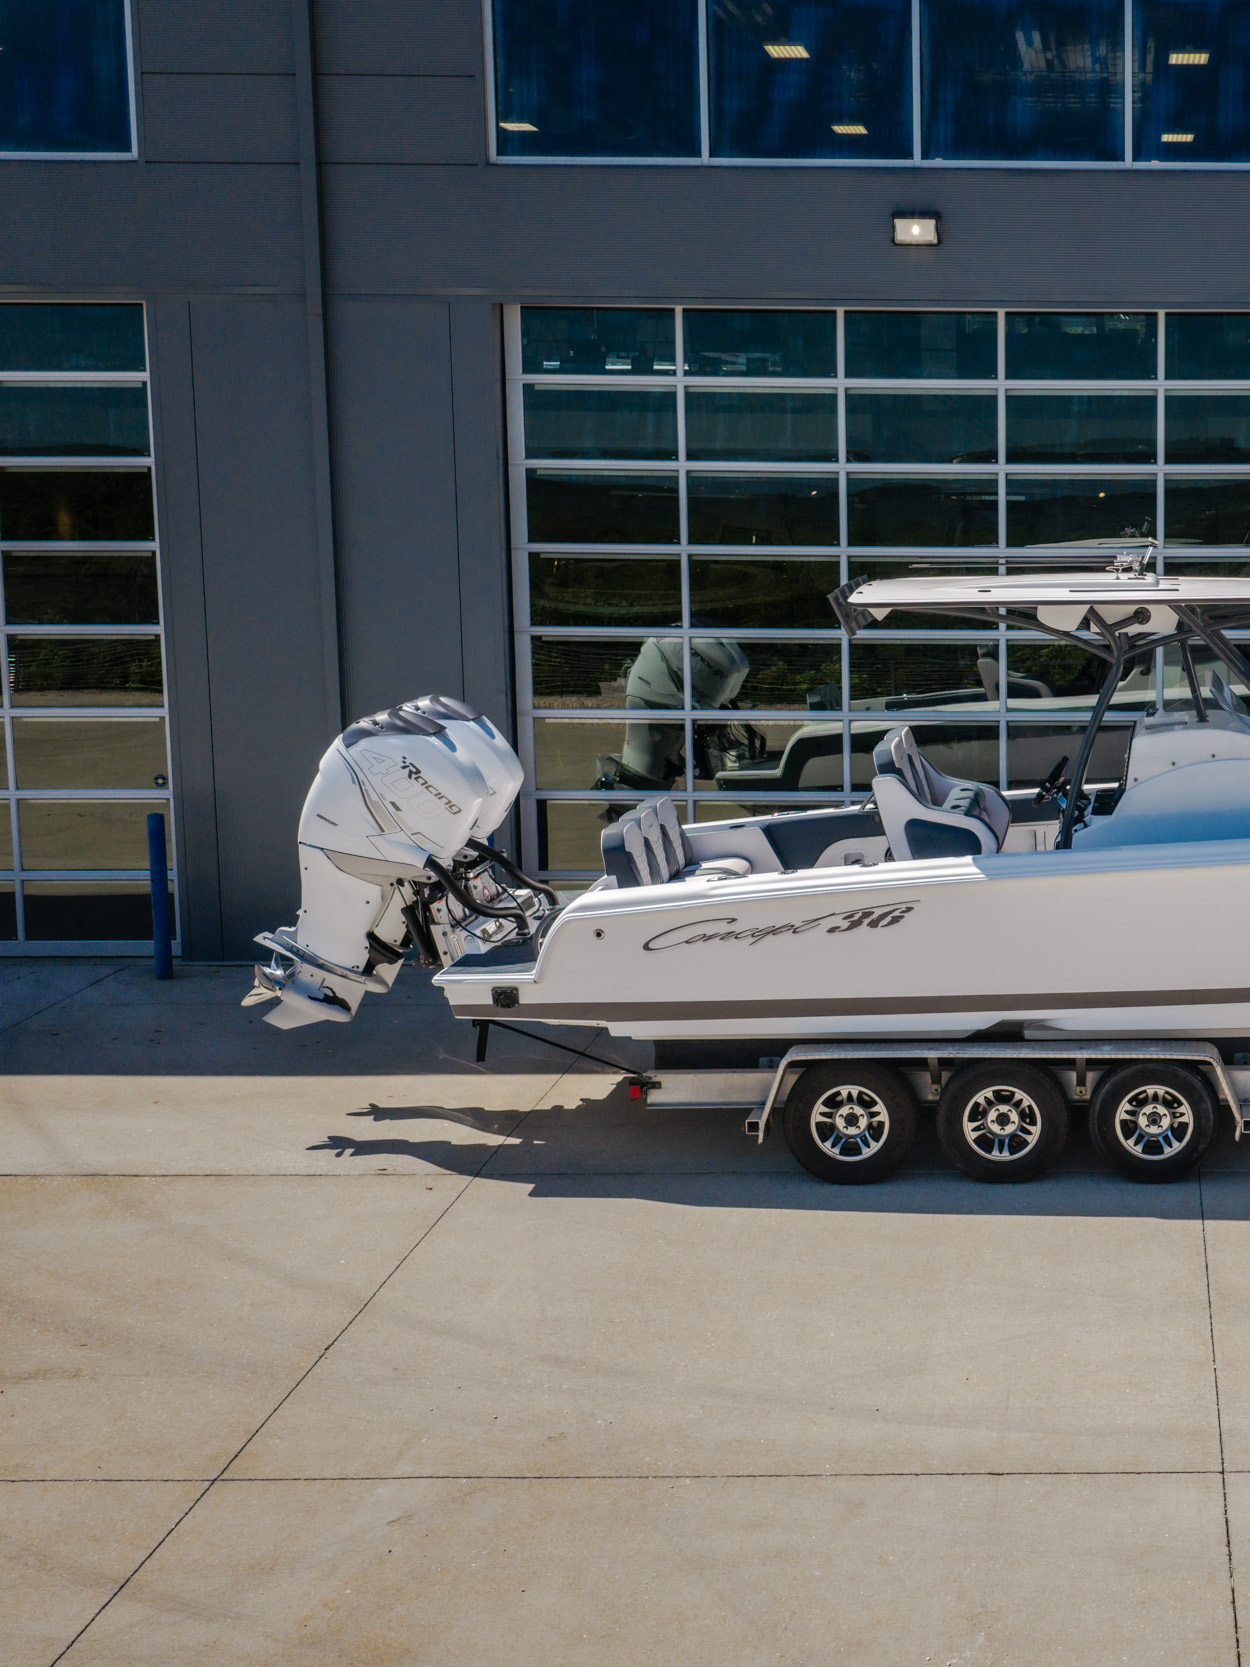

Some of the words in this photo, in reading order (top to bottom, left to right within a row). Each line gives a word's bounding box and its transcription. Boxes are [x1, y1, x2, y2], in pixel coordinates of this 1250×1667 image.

[400, 756, 462, 815] Racing
[642, 899, 921, 952] Concept
[826, 906, 914, 934] 36
